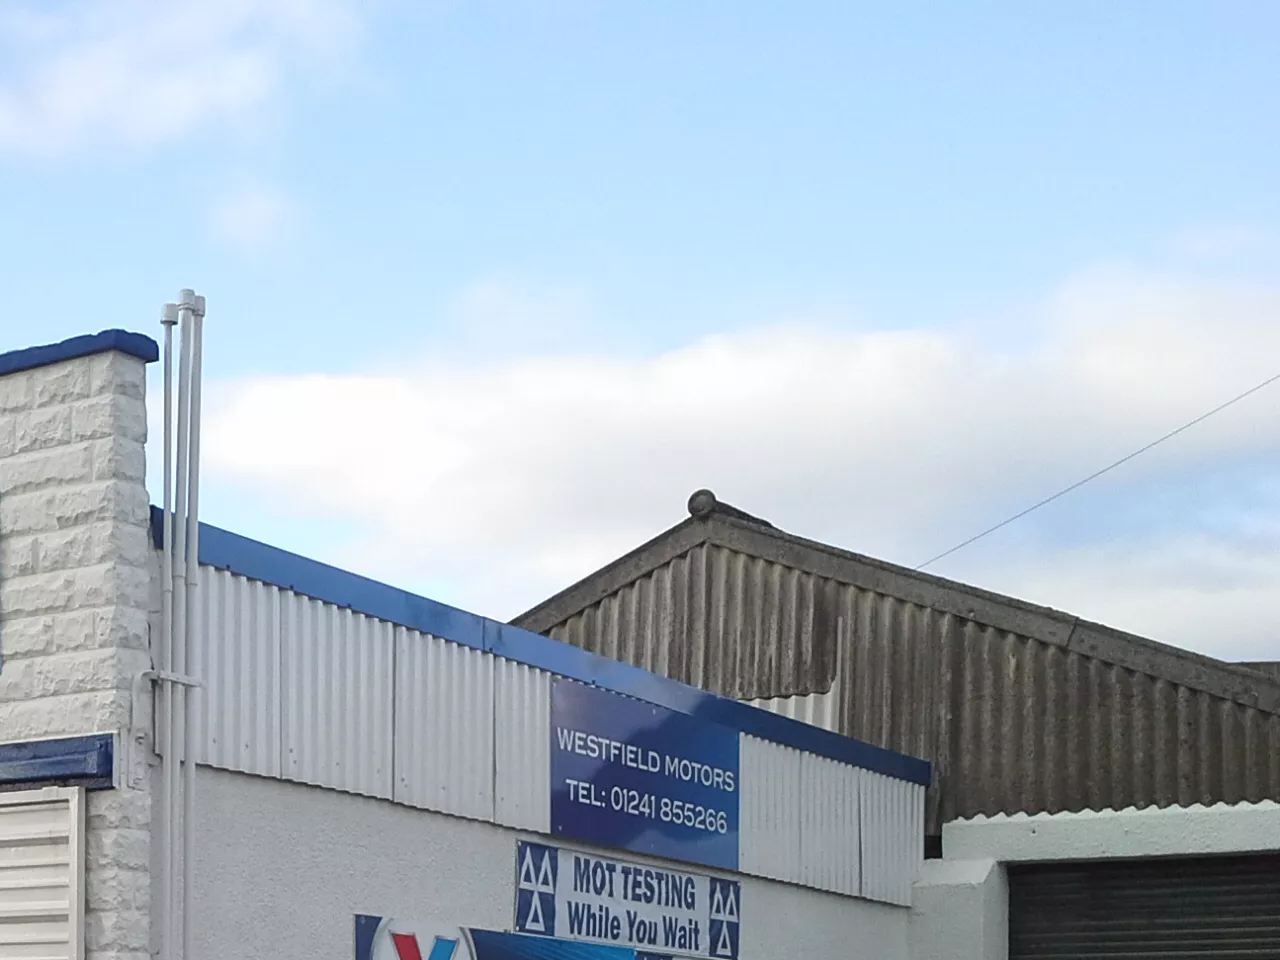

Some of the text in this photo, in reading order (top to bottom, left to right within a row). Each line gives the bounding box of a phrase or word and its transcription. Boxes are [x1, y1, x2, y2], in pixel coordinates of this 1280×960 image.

[557, 726, 735, 792] WESTFIELD MOTORS
[565, 779, 728, 834] TEL: 01241 855266
[573, 855, 696, 911] MOT TESTING
[567, 900, 700, 951] While You Wait
